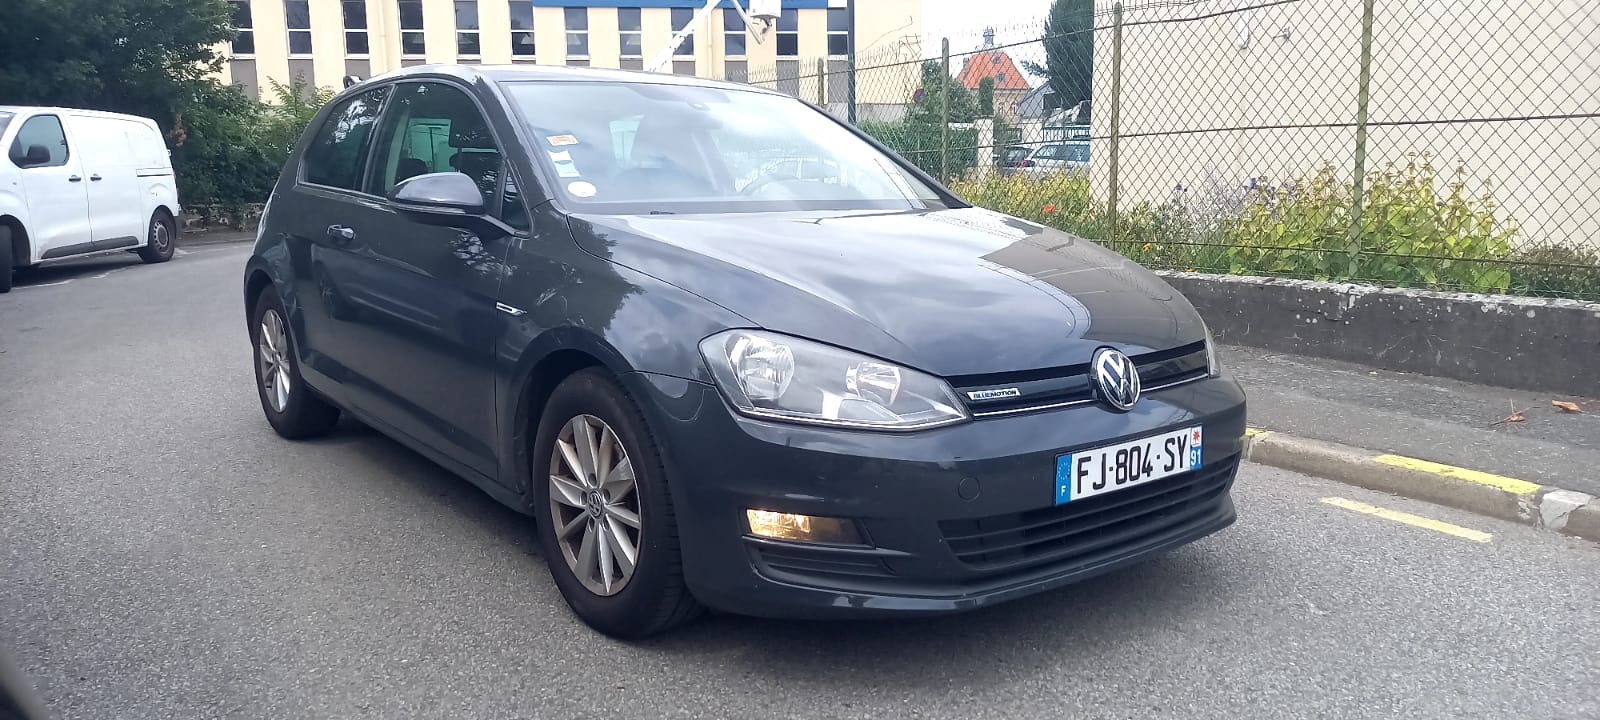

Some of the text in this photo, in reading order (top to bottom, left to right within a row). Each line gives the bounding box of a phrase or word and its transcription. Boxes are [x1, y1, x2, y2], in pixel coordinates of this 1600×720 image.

[973, 390, 1017, 399] BLUEMOTION
[1190, 449, 1201, 466] 91
[1061, 485, 1067, 497] F
